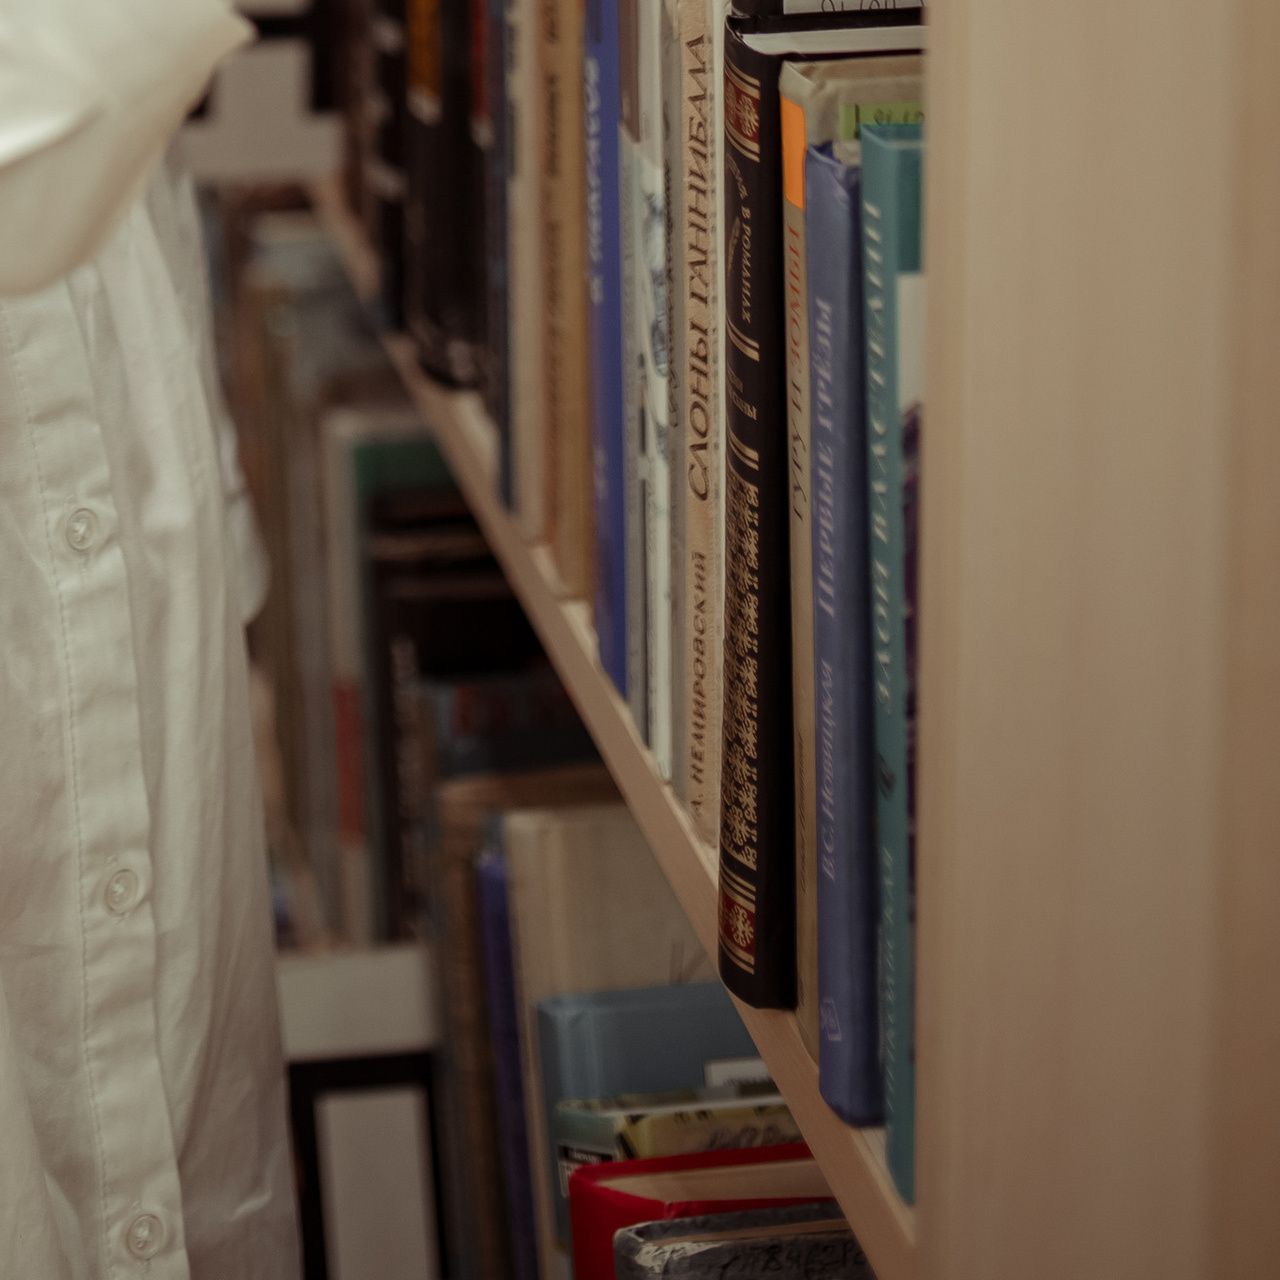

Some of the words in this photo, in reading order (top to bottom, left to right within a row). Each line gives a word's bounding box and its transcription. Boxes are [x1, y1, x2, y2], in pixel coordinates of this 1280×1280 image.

[685, 34, 710, 307] ГАННИБАЛА
[740, 227, 753, 325] РОМАНАХ
[786, 224, 804, 372] ЗОМБИ
[687, 325, 710, 501] СЛОНЫ
[789, 380, 804, 416] И
[863, 197, 888, 545] ВЛАСТЕЛИН
[790, 419, 808, 523] ГУРУ
[817, 443, 836, 619] ПЕРВЫЕ
[690, 550, 708, 785] НЕМИРОВСКИЙ
